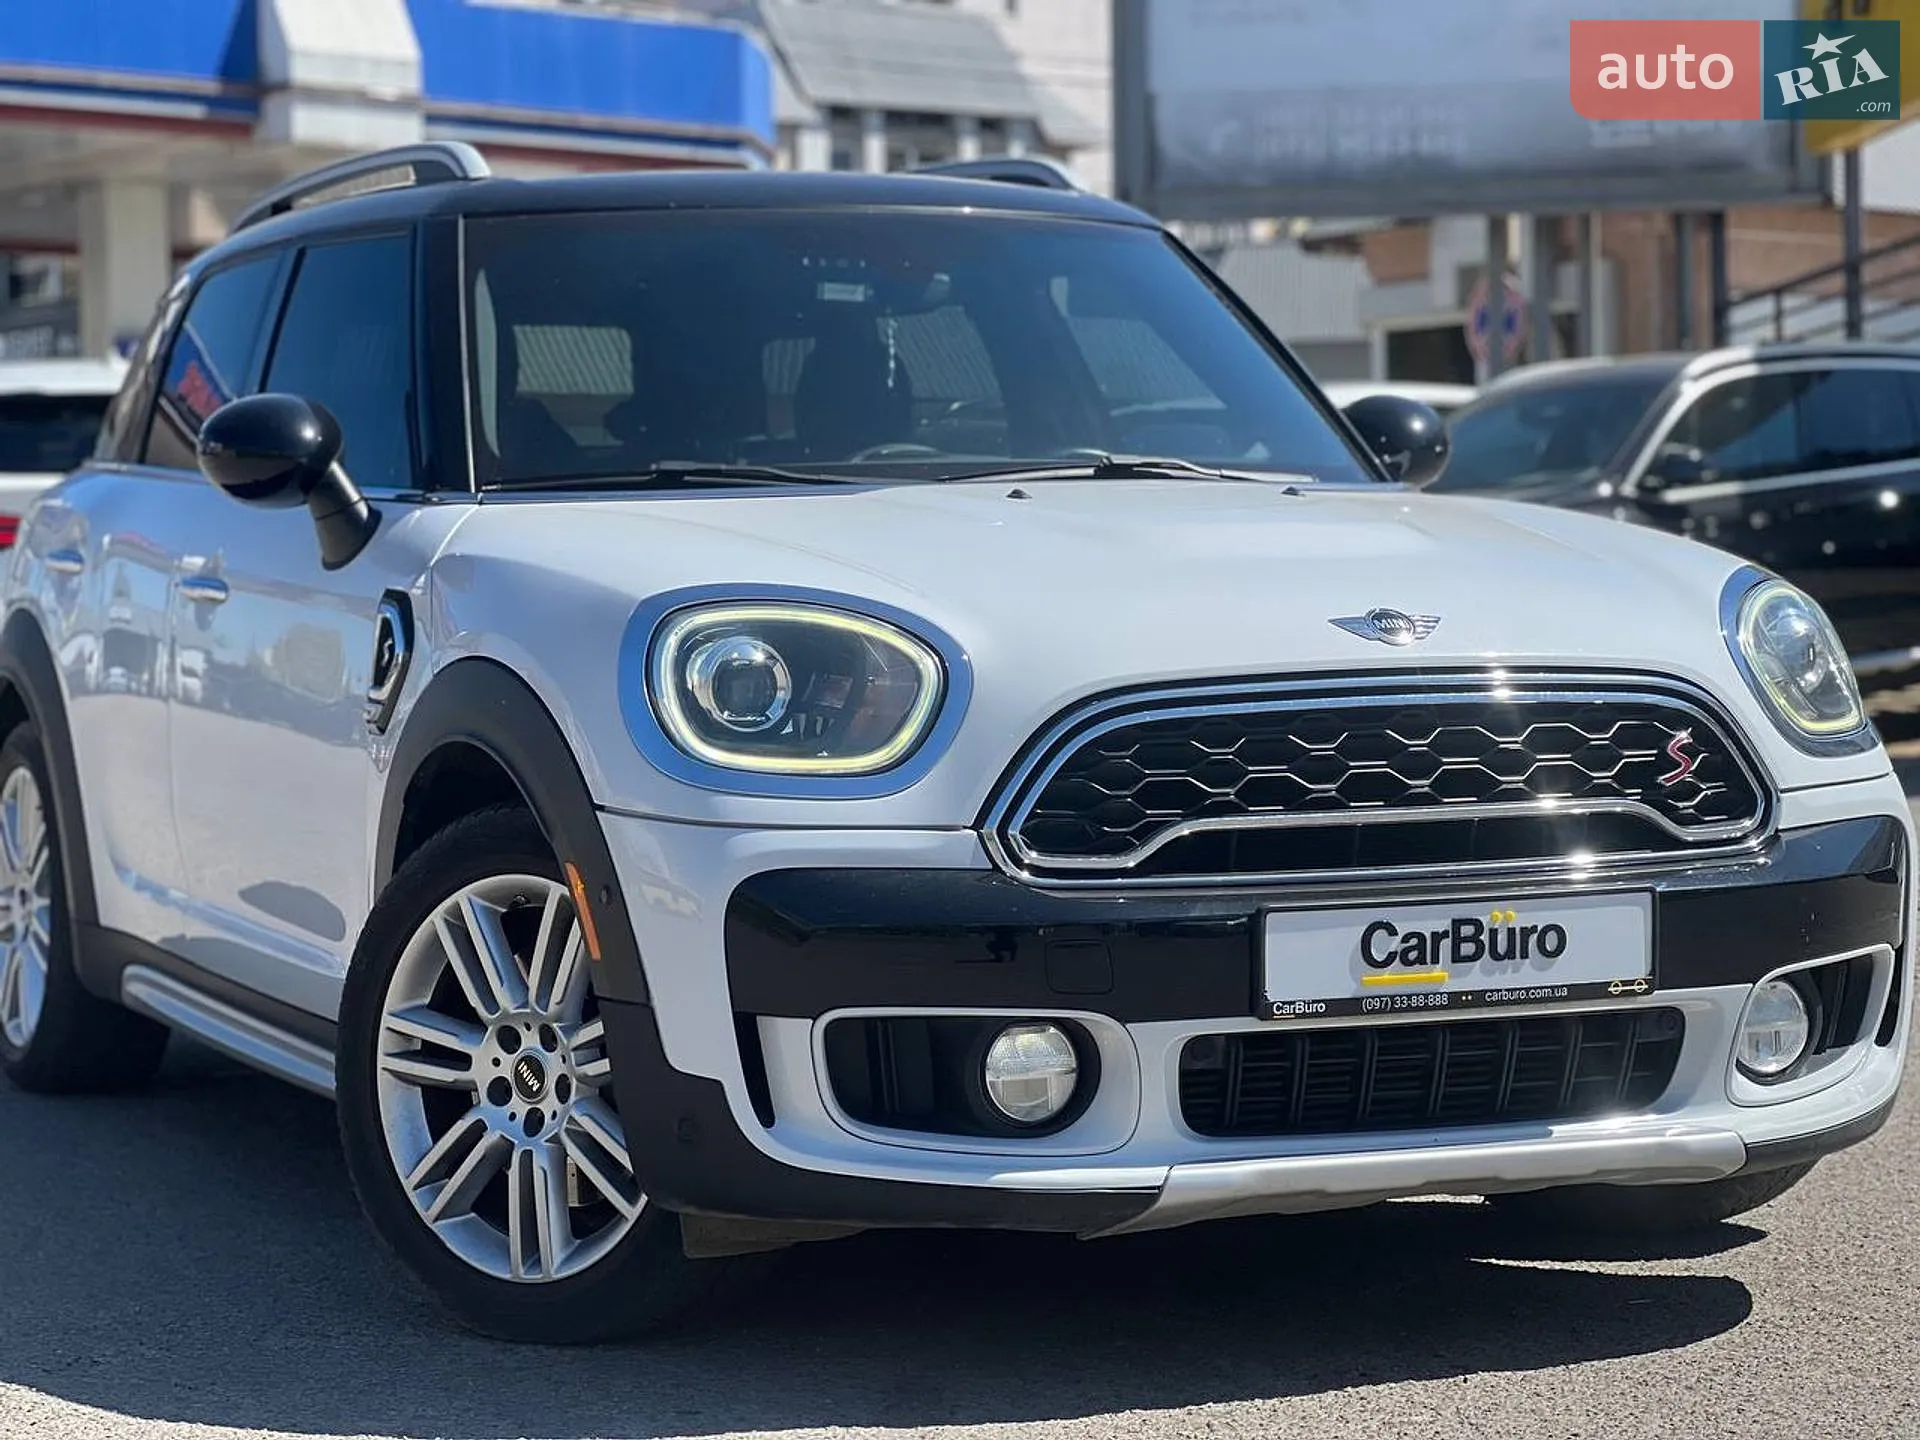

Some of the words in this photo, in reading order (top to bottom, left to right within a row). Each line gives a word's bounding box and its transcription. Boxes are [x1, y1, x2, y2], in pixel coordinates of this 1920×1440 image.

[1361, 909, 1567, 969] CarBüro
[1485, 986, 1568, 1002] carburo.com.ua
[1273, 1000, 1326, 1015] CarBüro
[1362, 997, 1392, 1013] (097)
[517, 1061, 541, 1092] MINI
